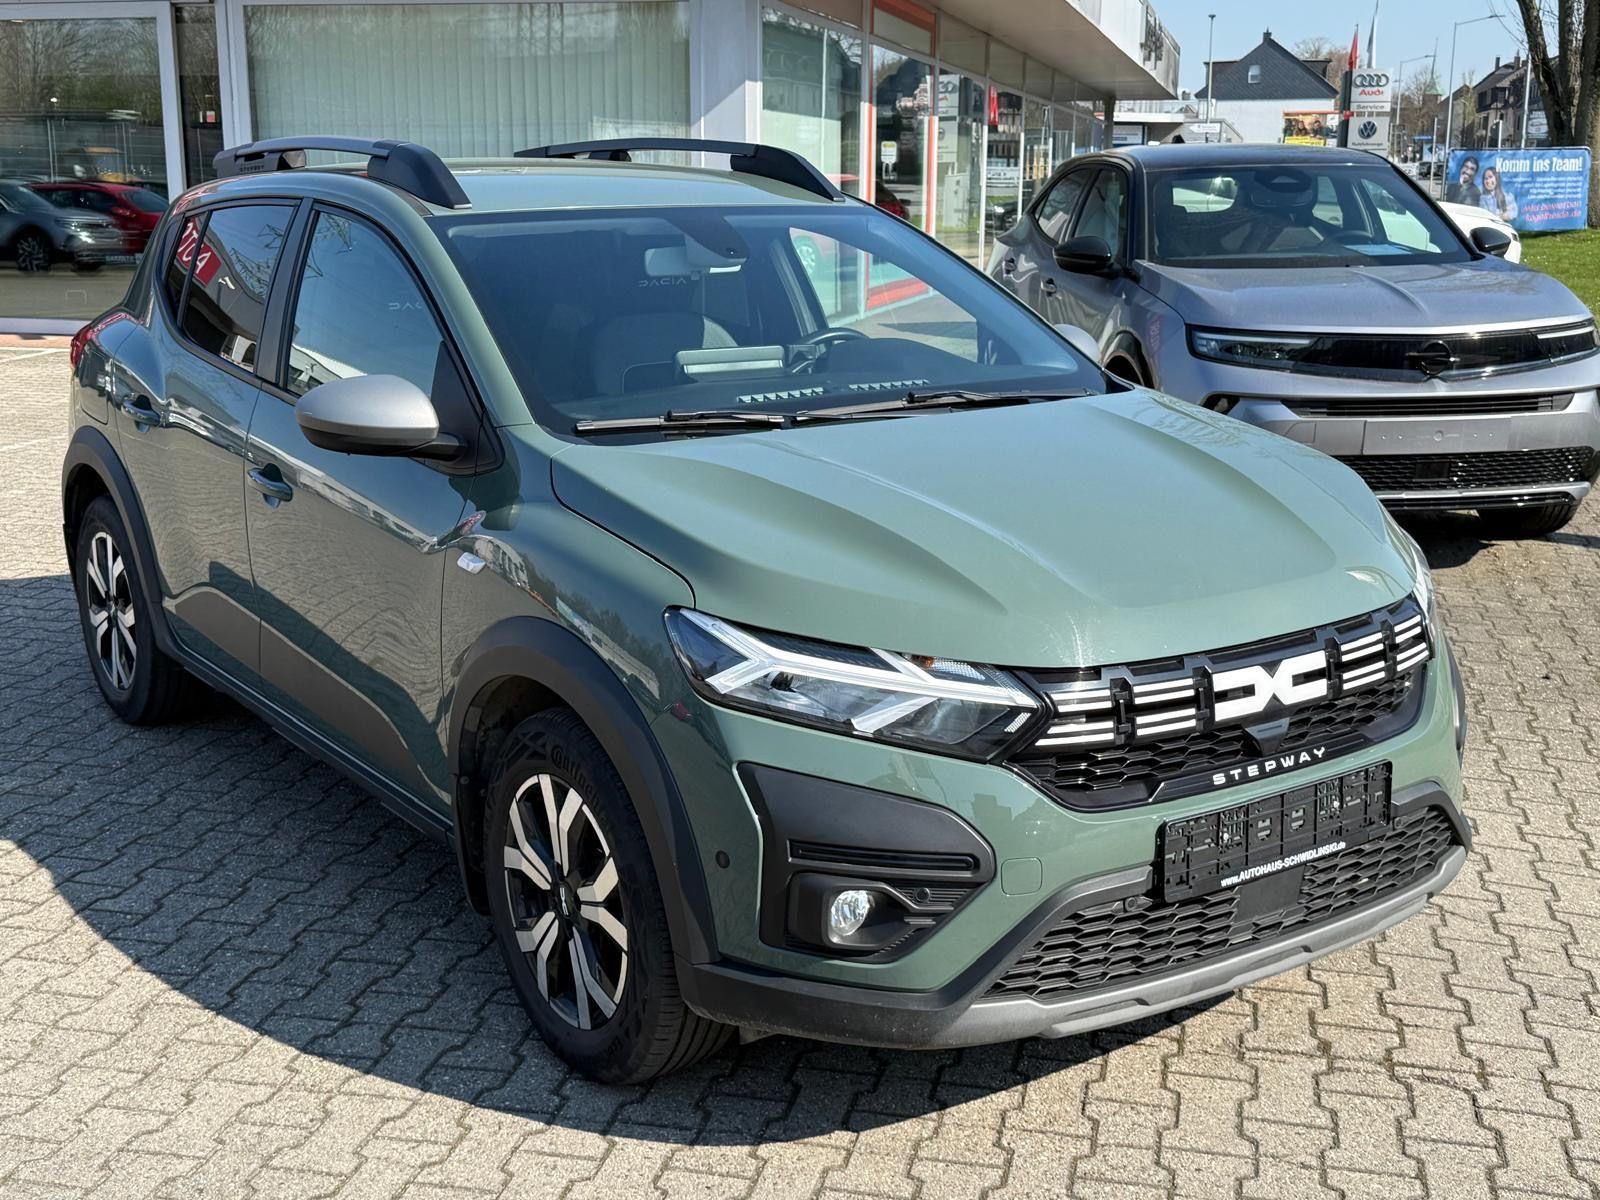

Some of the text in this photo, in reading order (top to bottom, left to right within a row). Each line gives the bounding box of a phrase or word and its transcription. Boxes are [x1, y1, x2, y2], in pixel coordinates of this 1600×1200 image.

[1359, 88, 1383, 96] Audi
[1496, 156, 1583, 172] Komm ins Team!
[639, 278, 687, 287] DACIA
[1213, 747, 1325, 785] STEPWAY
[1221, 841, 1346, 887] www.AUTOHAUS-SCHWIDLINSKI.de
